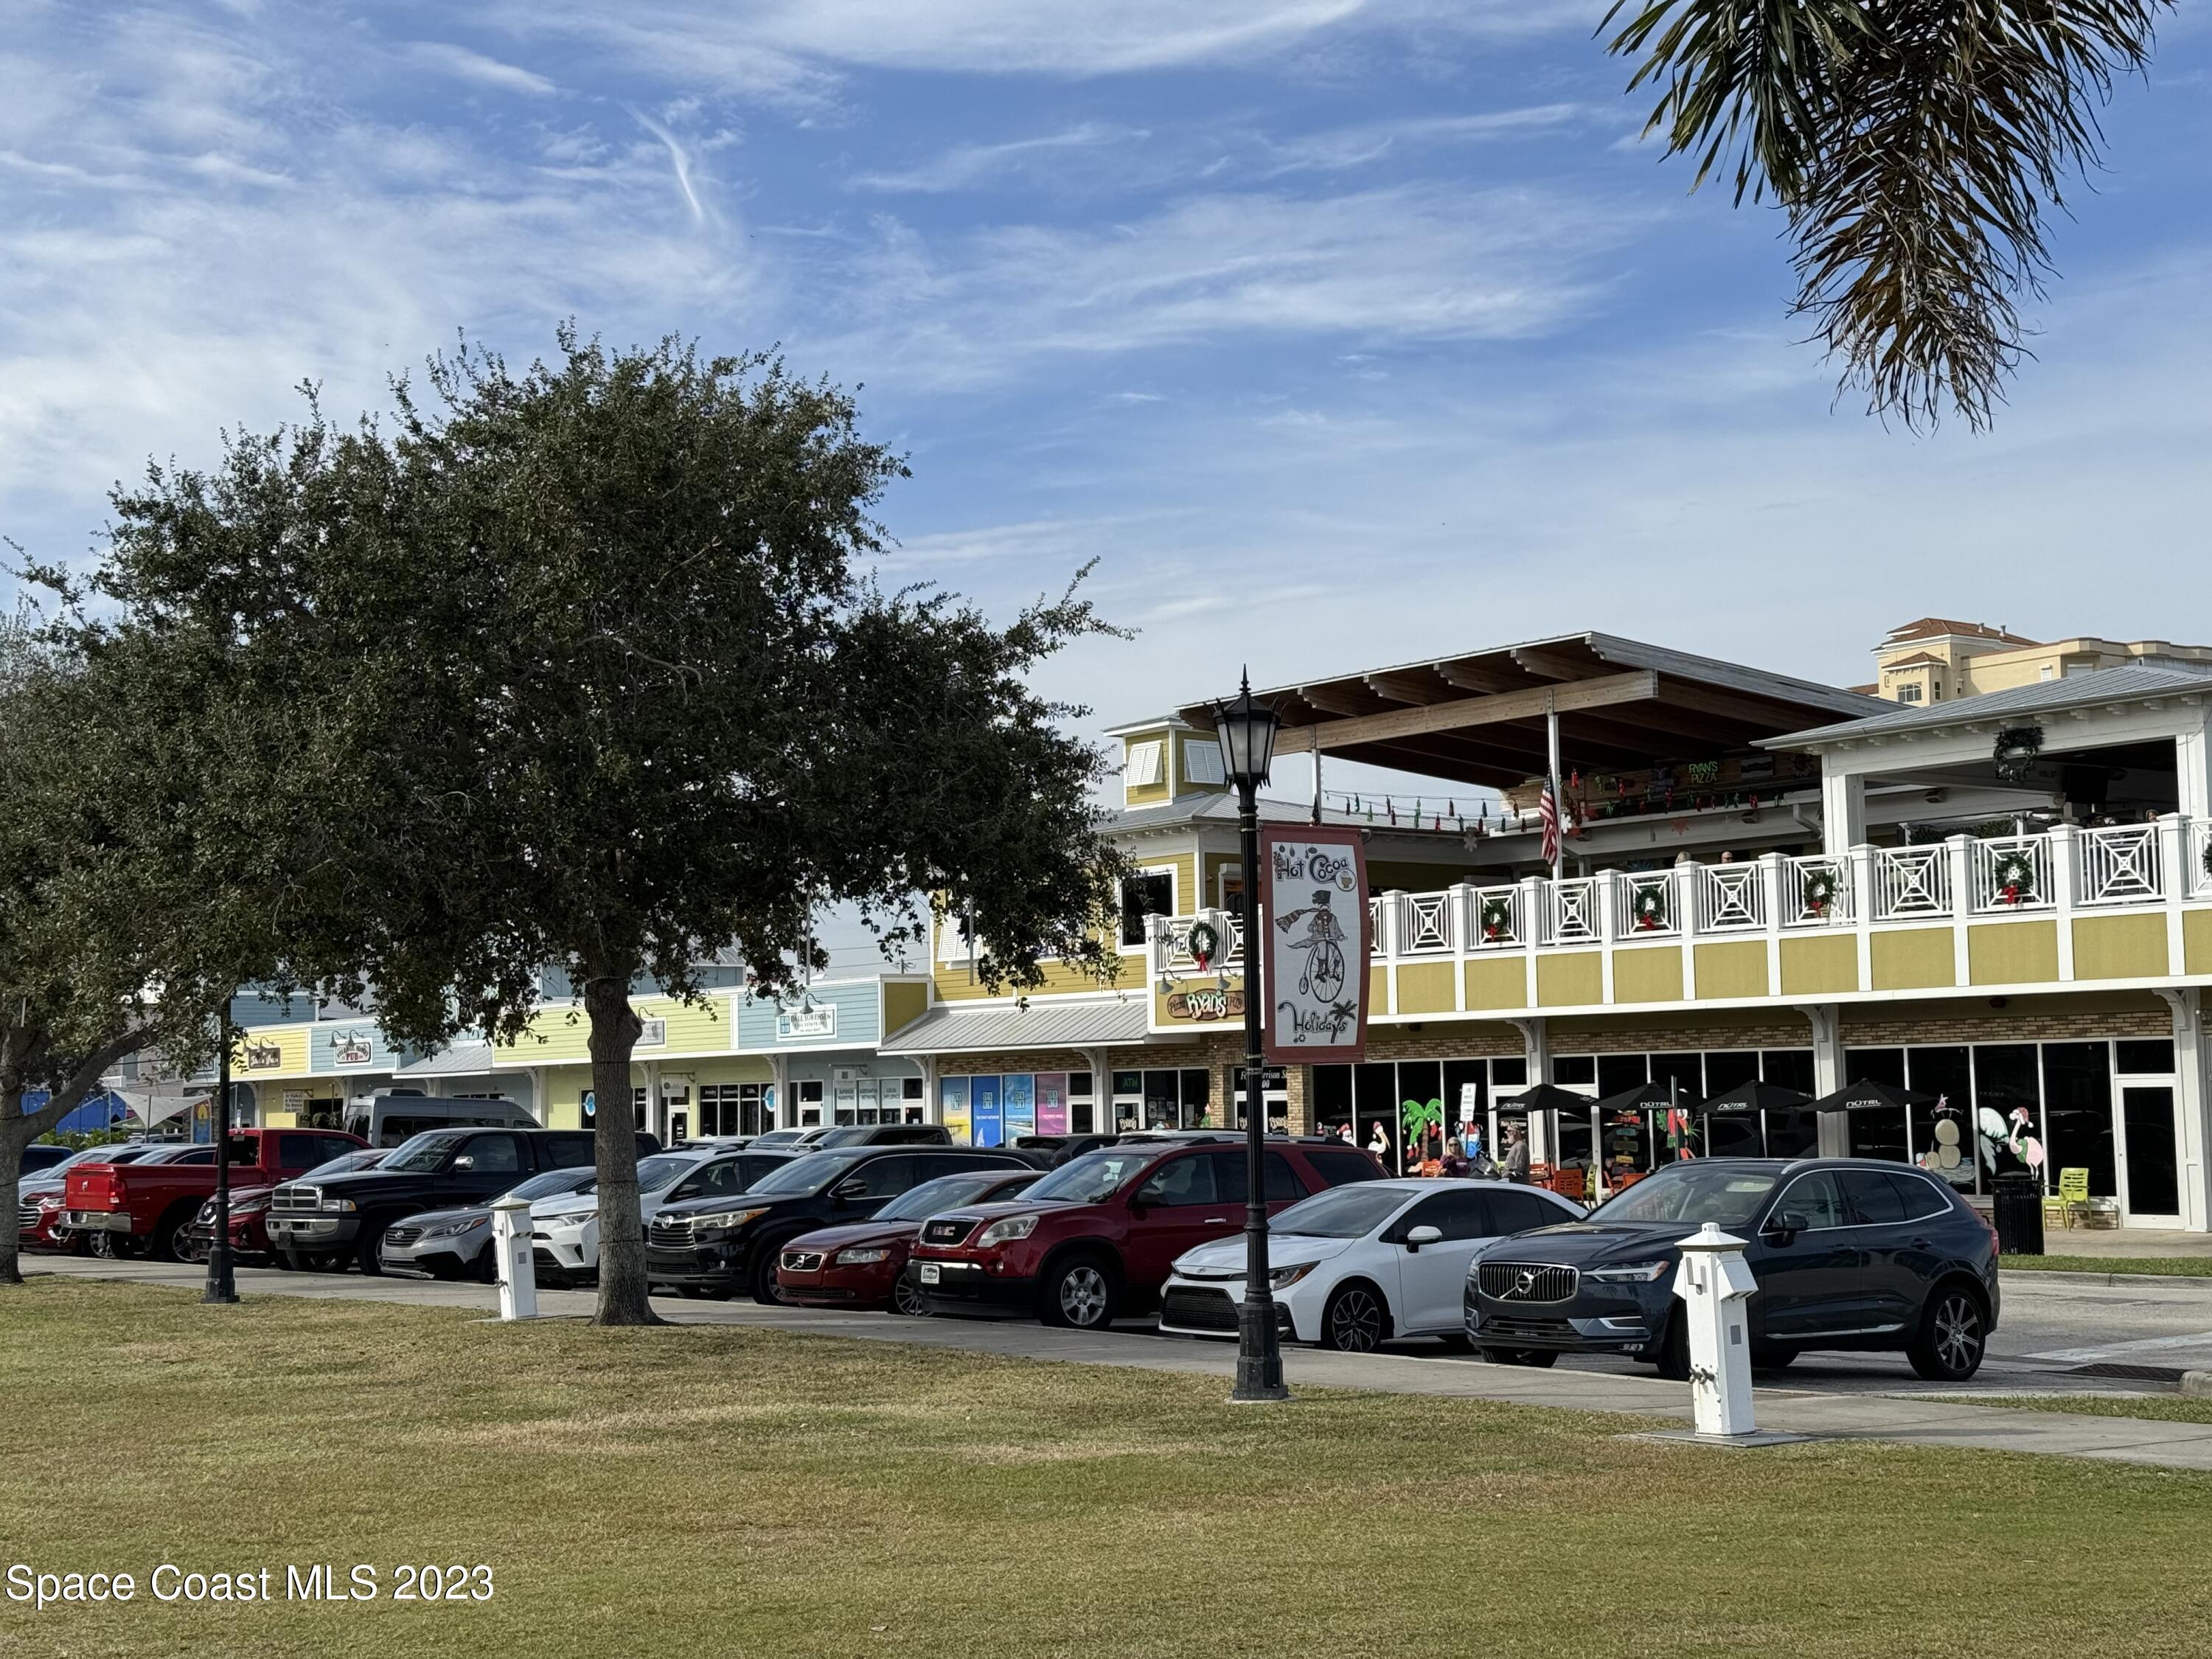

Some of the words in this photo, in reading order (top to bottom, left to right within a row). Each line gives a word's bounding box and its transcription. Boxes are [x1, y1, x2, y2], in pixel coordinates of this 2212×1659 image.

[1688, 761, 1718, 773] RYAN'S
[1691, 772, 1717, 784] PIZZA
[1275, 853, 1306, 881] Hot
[1310, 853, 1349, 883] Cocoa
[1186, 990, 1227, 1019] Ryan's
[1278, 1001, 1349, 1041] Holidays
[346, 1052, 358, 1060] PUB
[1262, 1070, 1280, 1079] rrison
[1122, 1077, 1138, 1088] ATM
